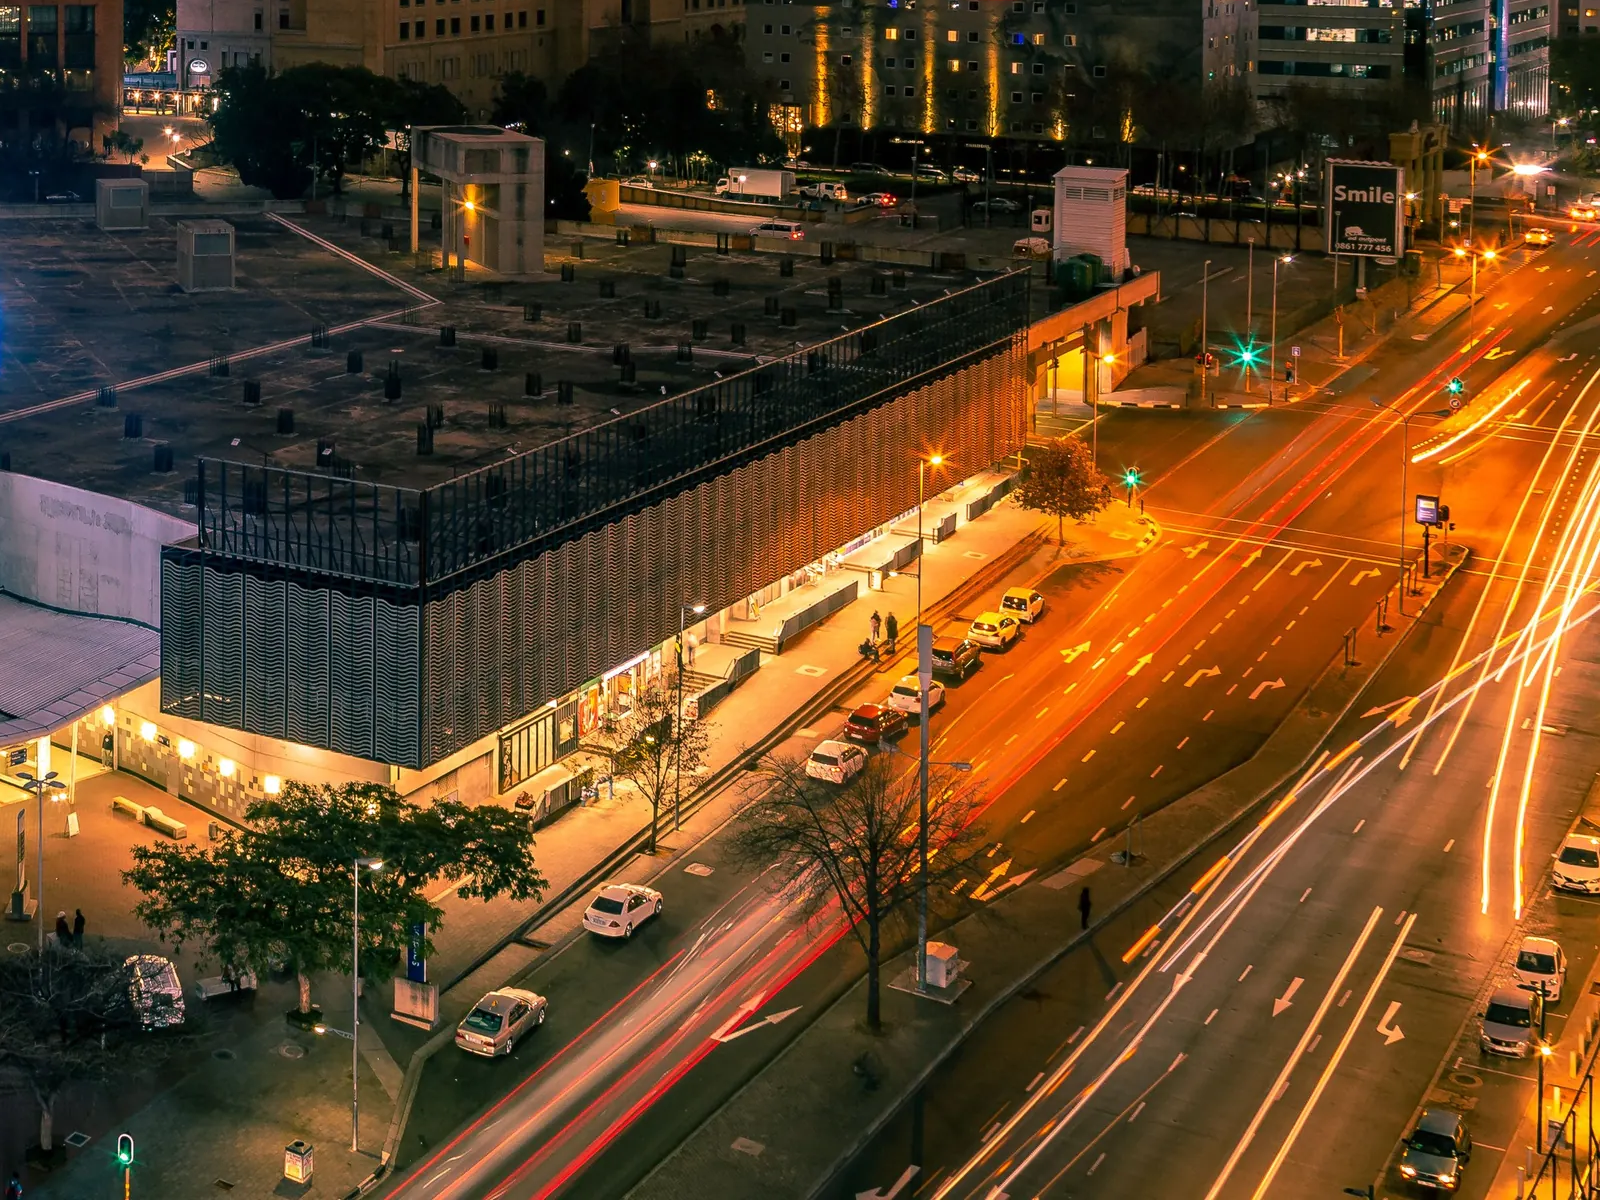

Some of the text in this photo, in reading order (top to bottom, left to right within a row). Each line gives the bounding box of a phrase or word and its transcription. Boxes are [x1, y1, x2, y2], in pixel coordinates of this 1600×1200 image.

[1334, 185, 1395, 204] Smile
[1334, 242, 1392, 253] 0861 777 456
